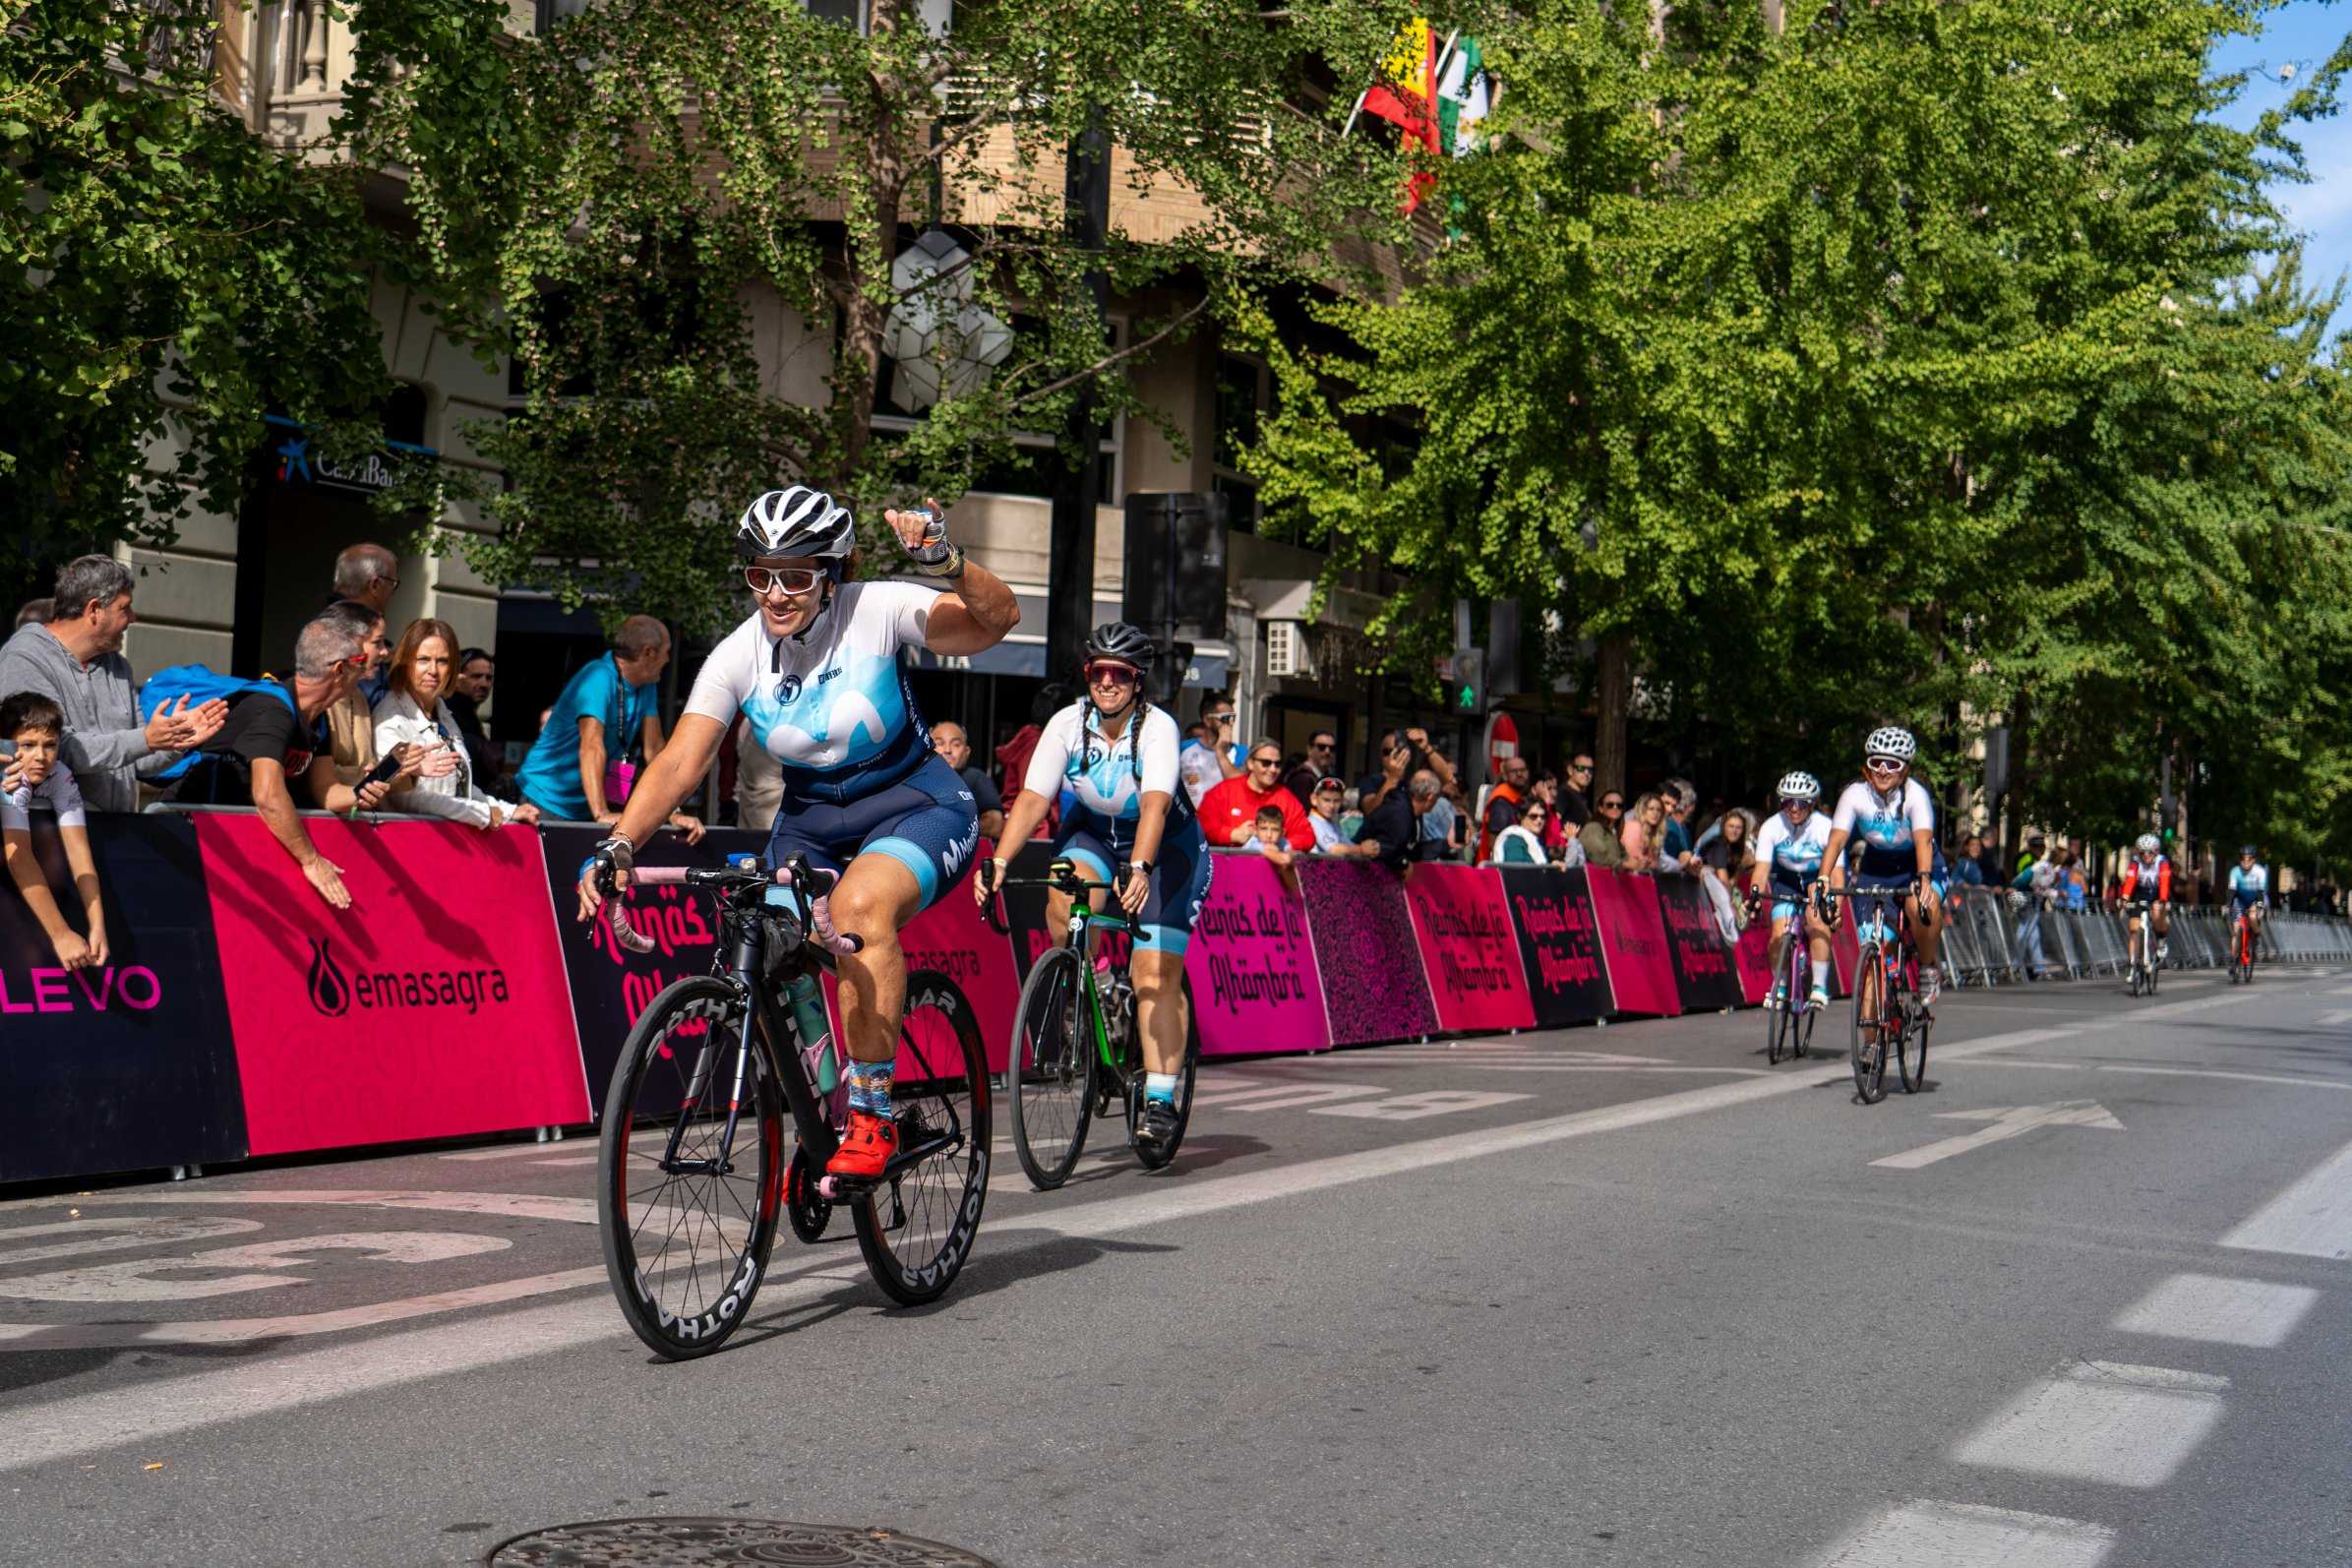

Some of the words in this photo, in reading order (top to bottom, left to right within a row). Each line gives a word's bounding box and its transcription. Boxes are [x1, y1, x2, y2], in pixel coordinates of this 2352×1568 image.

[1256, 893, 1284, 937] de
[903, 949, 981, 987] masagra
[355, 968, 510, 1015] emasagra
